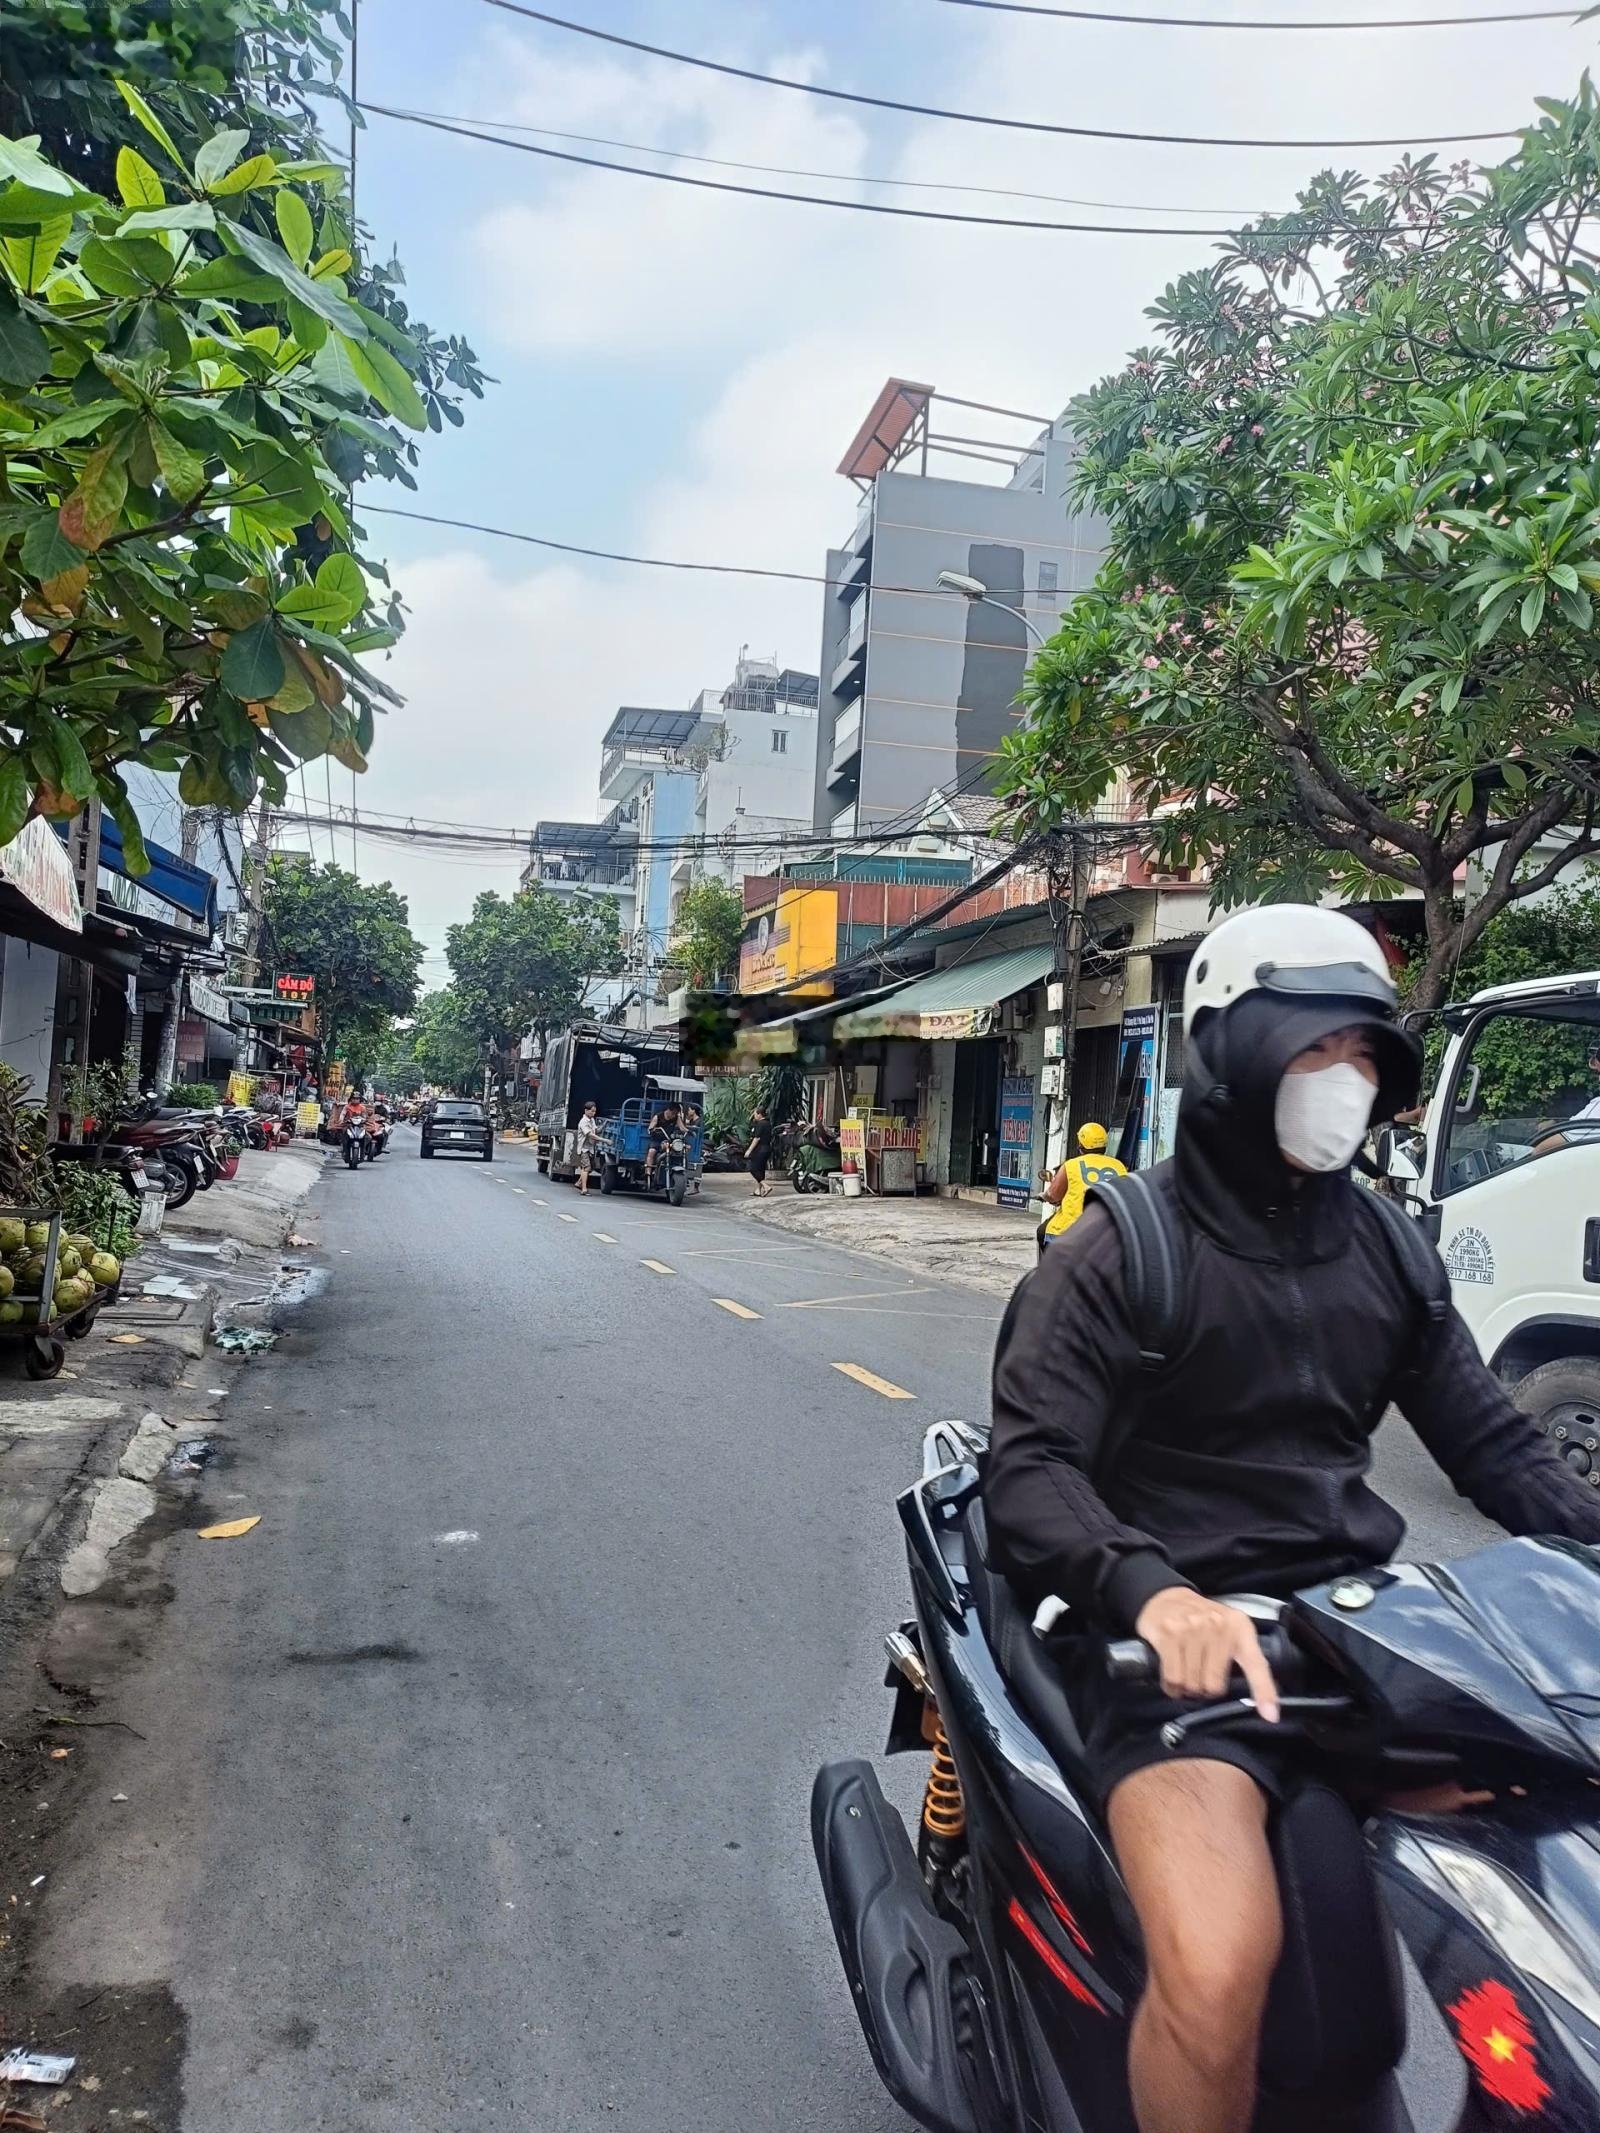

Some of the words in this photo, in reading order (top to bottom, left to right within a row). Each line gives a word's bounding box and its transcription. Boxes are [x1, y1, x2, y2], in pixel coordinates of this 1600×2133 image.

[928, 1014, 970, 1028] ĐẠT
[1465, 1271, 1477, 1280] 168
[1480, 1273, 1492, 1282] 168
